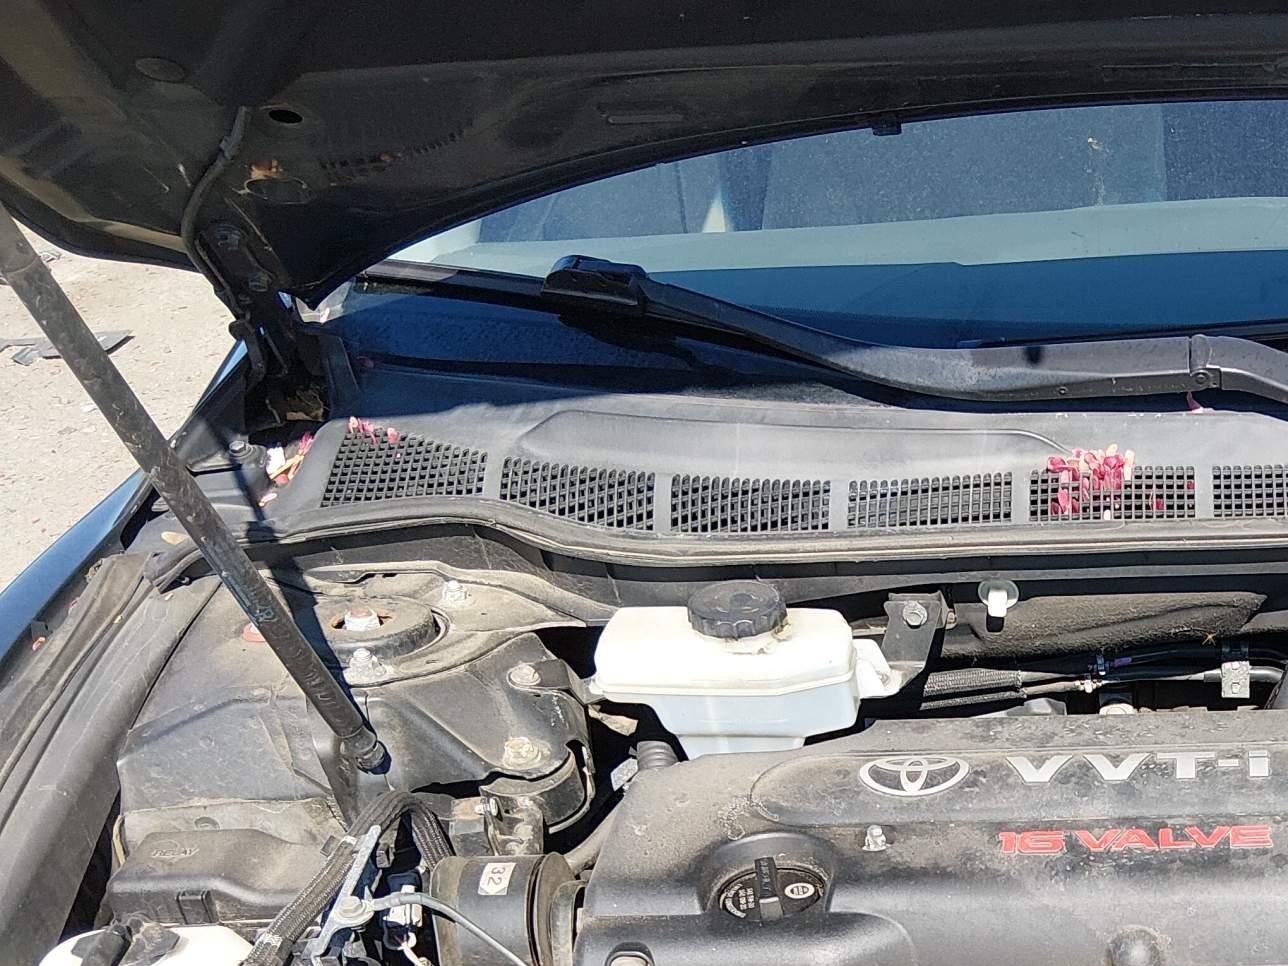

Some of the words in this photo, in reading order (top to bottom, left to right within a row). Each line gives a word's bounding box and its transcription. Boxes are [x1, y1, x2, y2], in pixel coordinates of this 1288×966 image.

[1006, 750, 1271, 783] VVT-i
[999, 830, 1068, 855] 16
[1075, 825, 1272, 852] VALVE
[487, 867, 506, 886] 32
